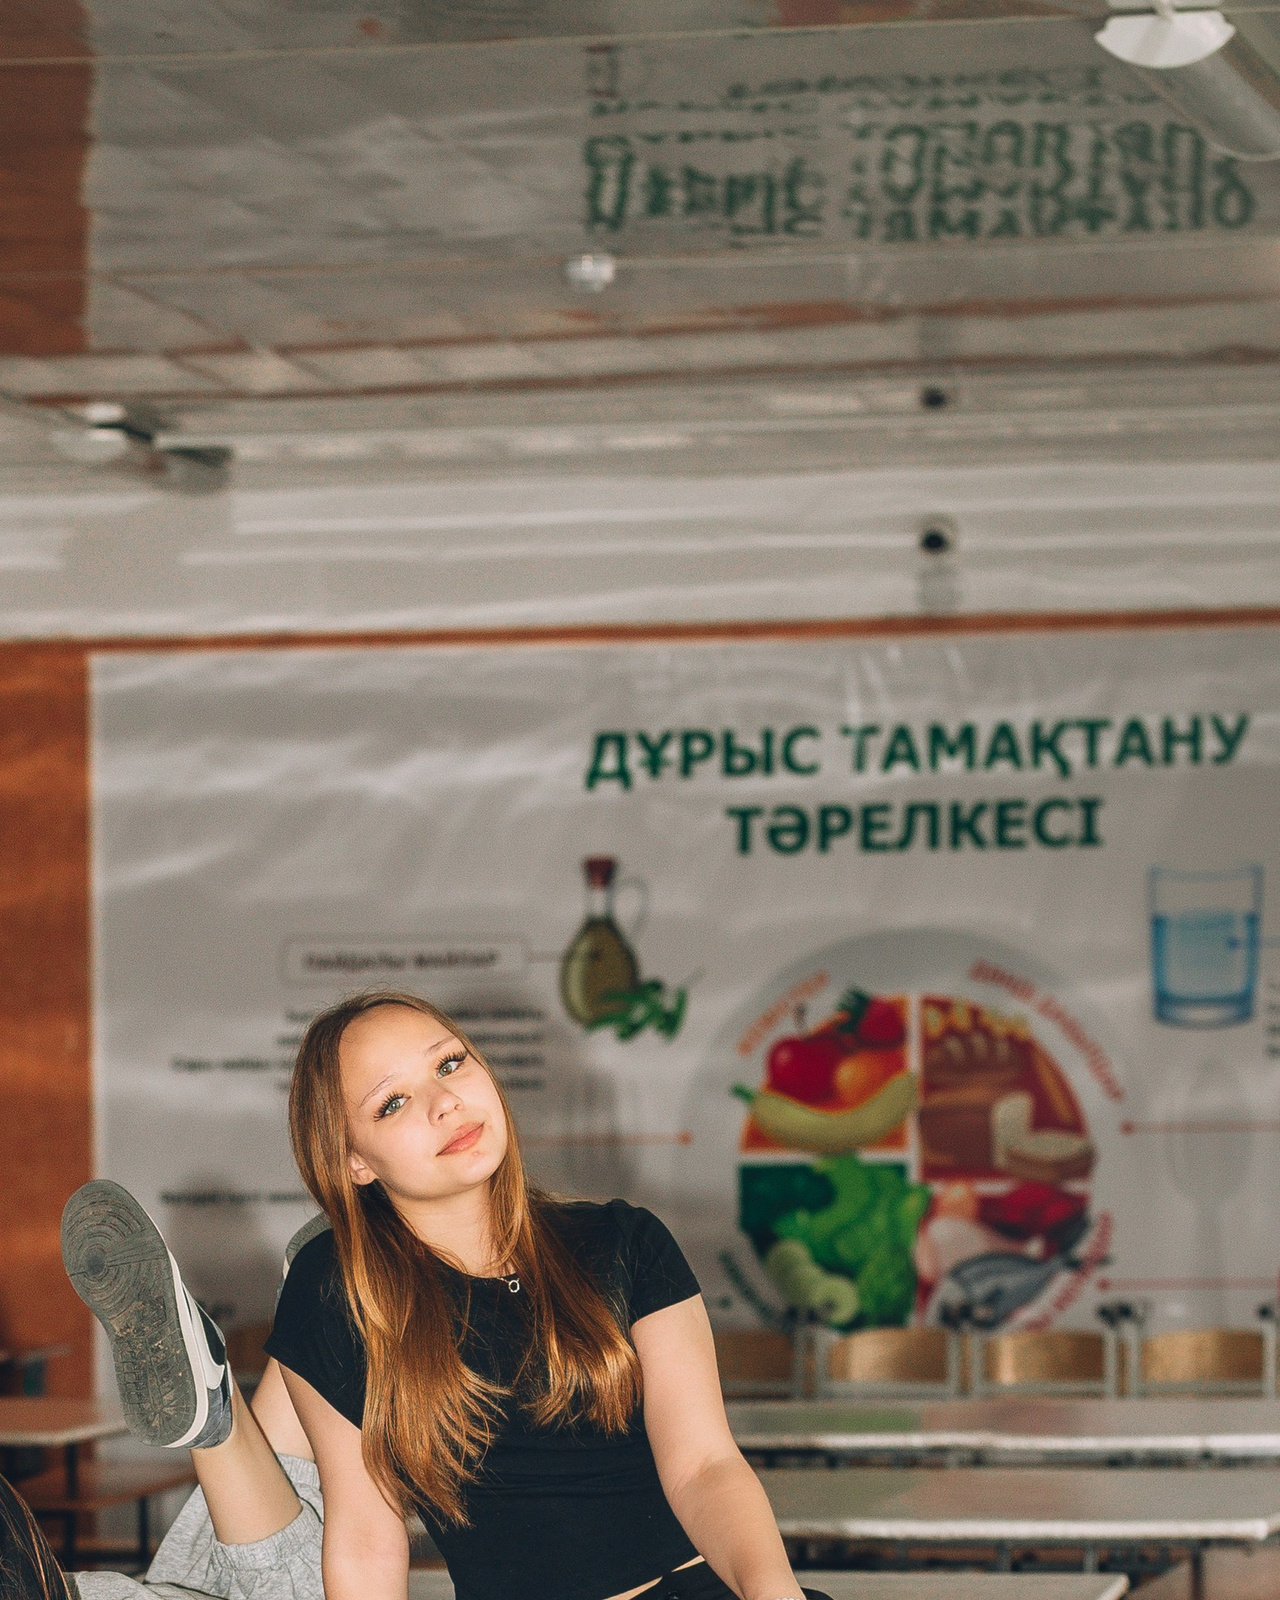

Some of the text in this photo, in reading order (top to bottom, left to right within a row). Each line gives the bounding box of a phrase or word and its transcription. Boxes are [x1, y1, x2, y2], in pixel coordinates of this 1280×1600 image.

[585, 712, 1251, 792] ДҰРЫС ТАМАҚТАНУ
[727, 798, 1105, 856] ТӘРЕЛКЕСІ
